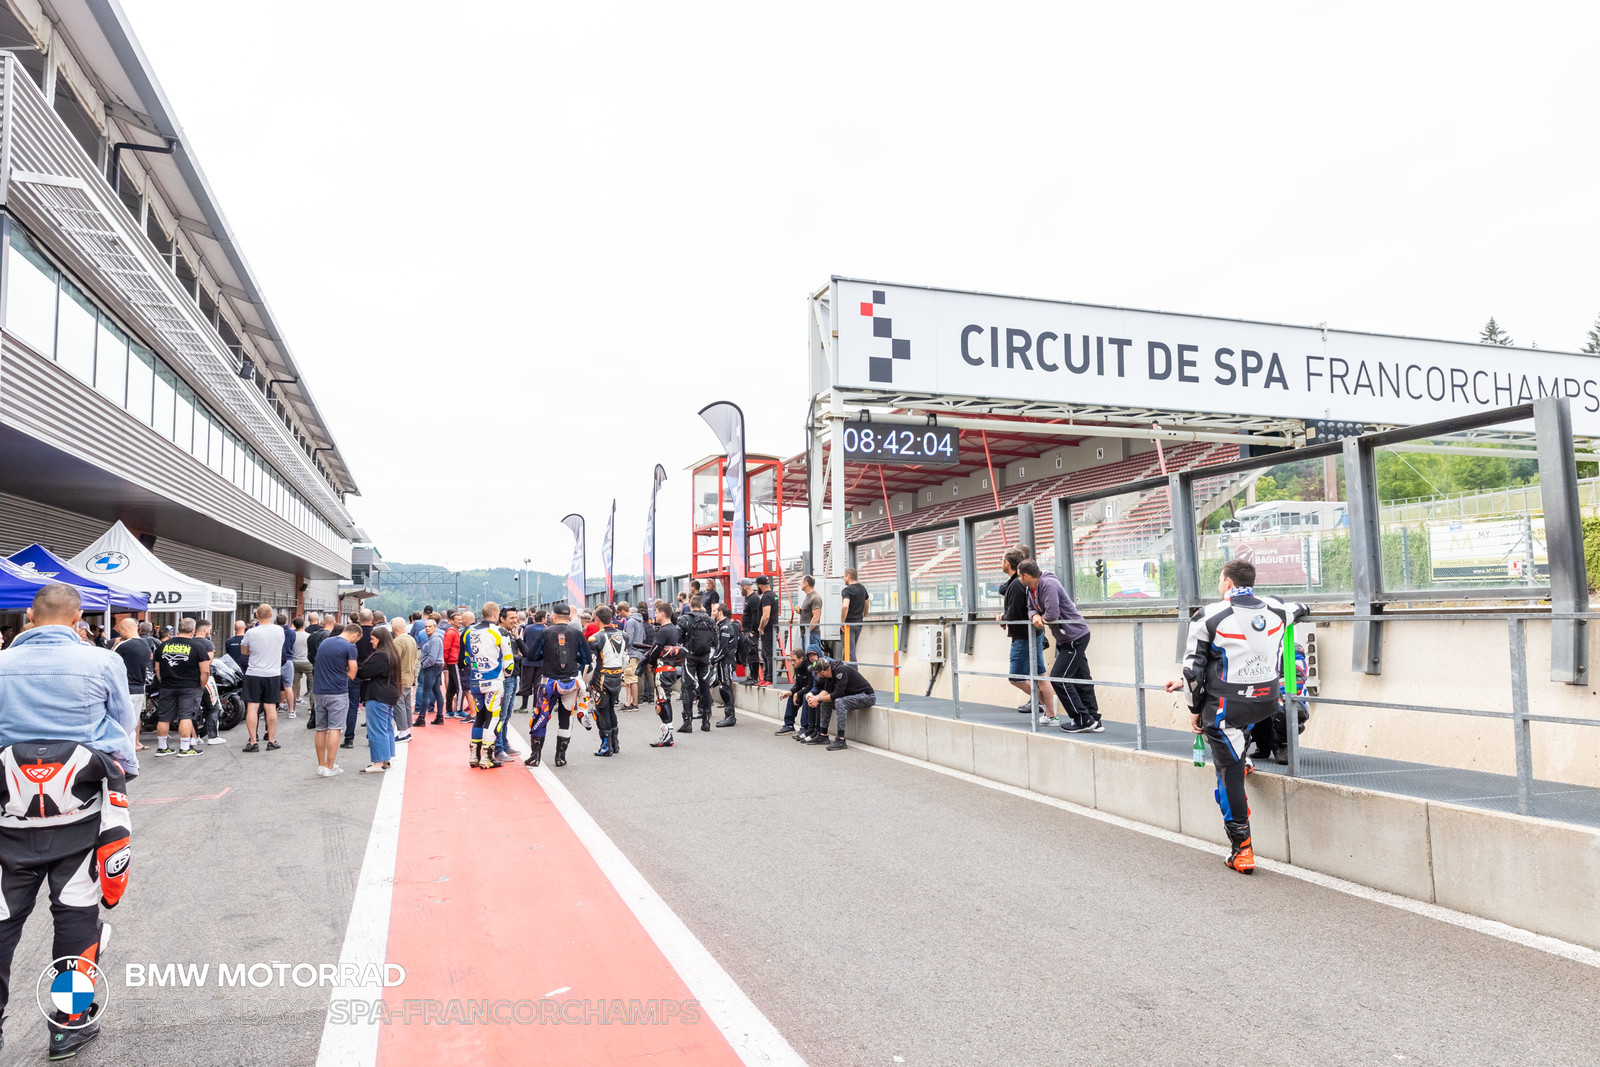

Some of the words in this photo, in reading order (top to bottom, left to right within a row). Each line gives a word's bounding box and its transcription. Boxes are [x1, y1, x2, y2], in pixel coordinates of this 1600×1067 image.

[960, 323, 1133, 379] CIRCUIT
[1147, 340, 1200, 383] DE
[1214, 347, 1290, 391] SPA
[1306, 355, 1600, 413] FRANCORCHAMPS
[843, 427, 954, 457] 08:42:04
[1254, 554, 1301, 565] BAGUETTE
[162, 644, 191, 656] ASSEN
